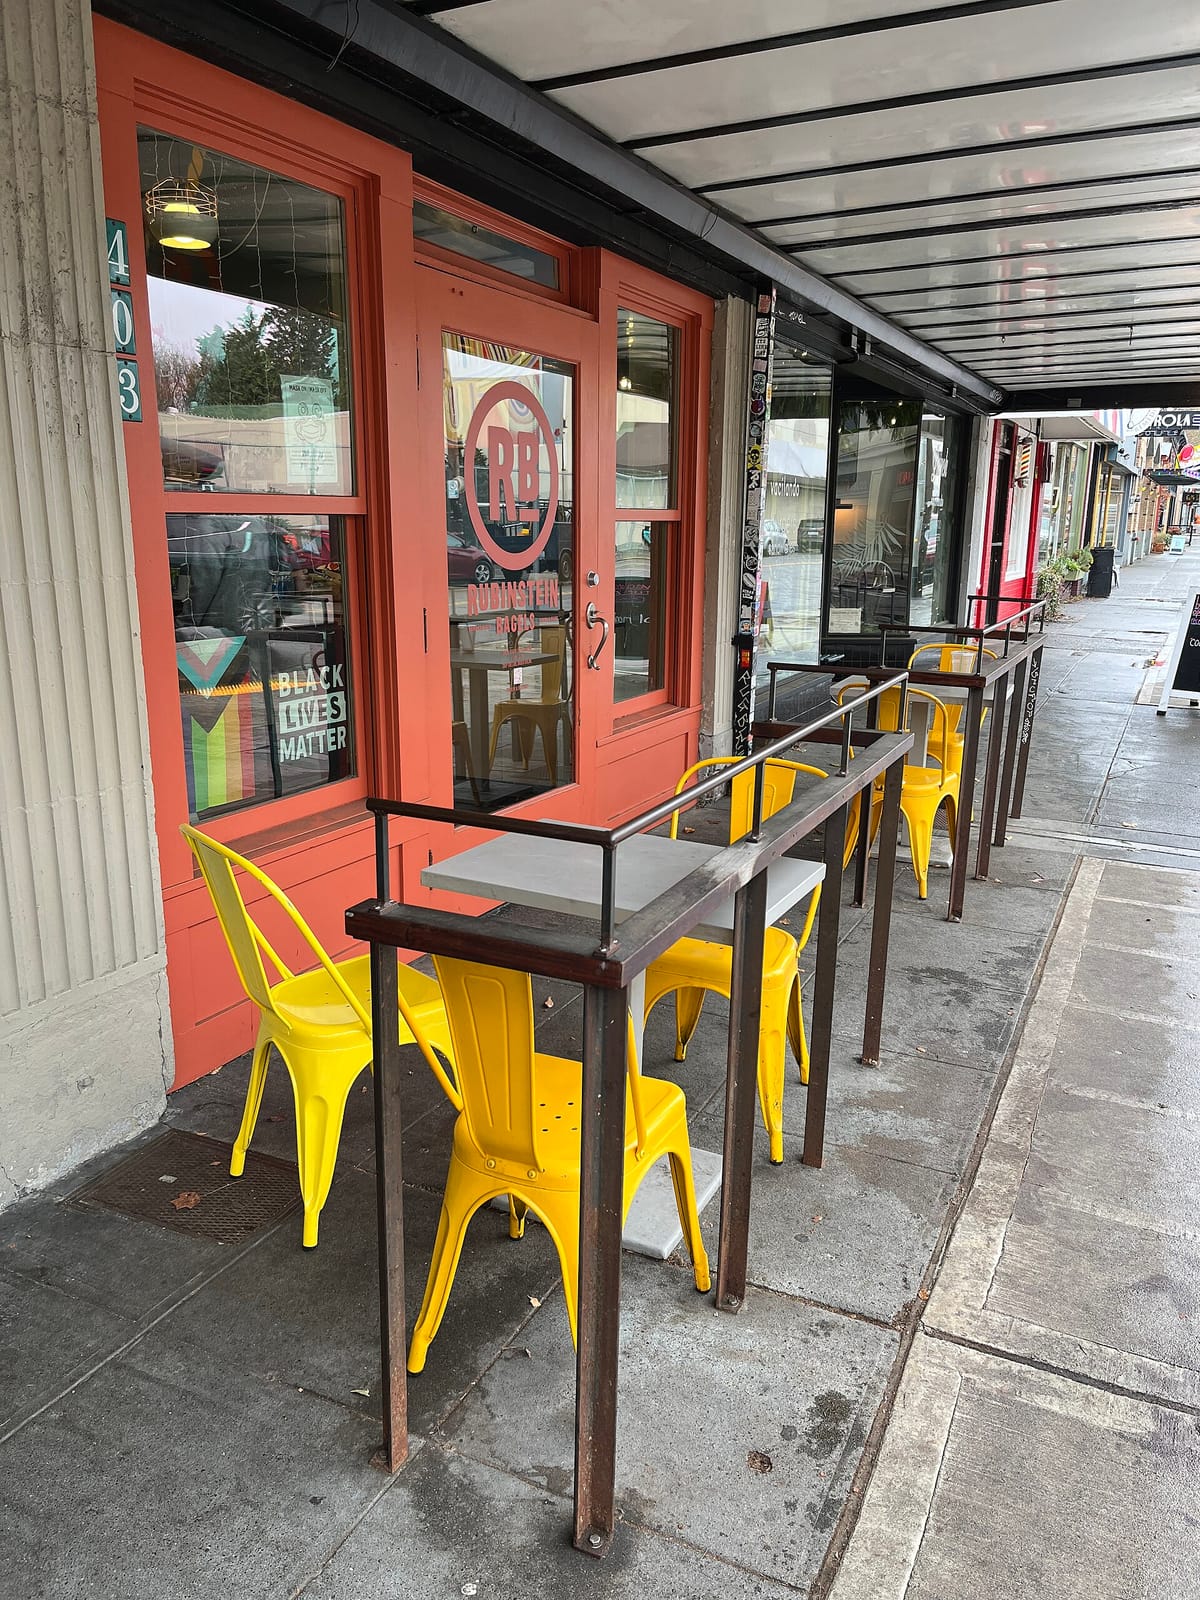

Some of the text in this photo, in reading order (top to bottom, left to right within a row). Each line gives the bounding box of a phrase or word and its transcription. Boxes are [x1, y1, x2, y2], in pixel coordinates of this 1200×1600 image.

[488, 426, 540, 522] RB
[770, 478, 800, 497] vacilando
[467, 579, 559, 616] RUBINSTEIN
[496, 612, 535, 635] BAGELS
[278, 664, 344, 698] BLACK
[285, 695, 342, 730] LIVES
[279, 726, 346, 763] MATTER
